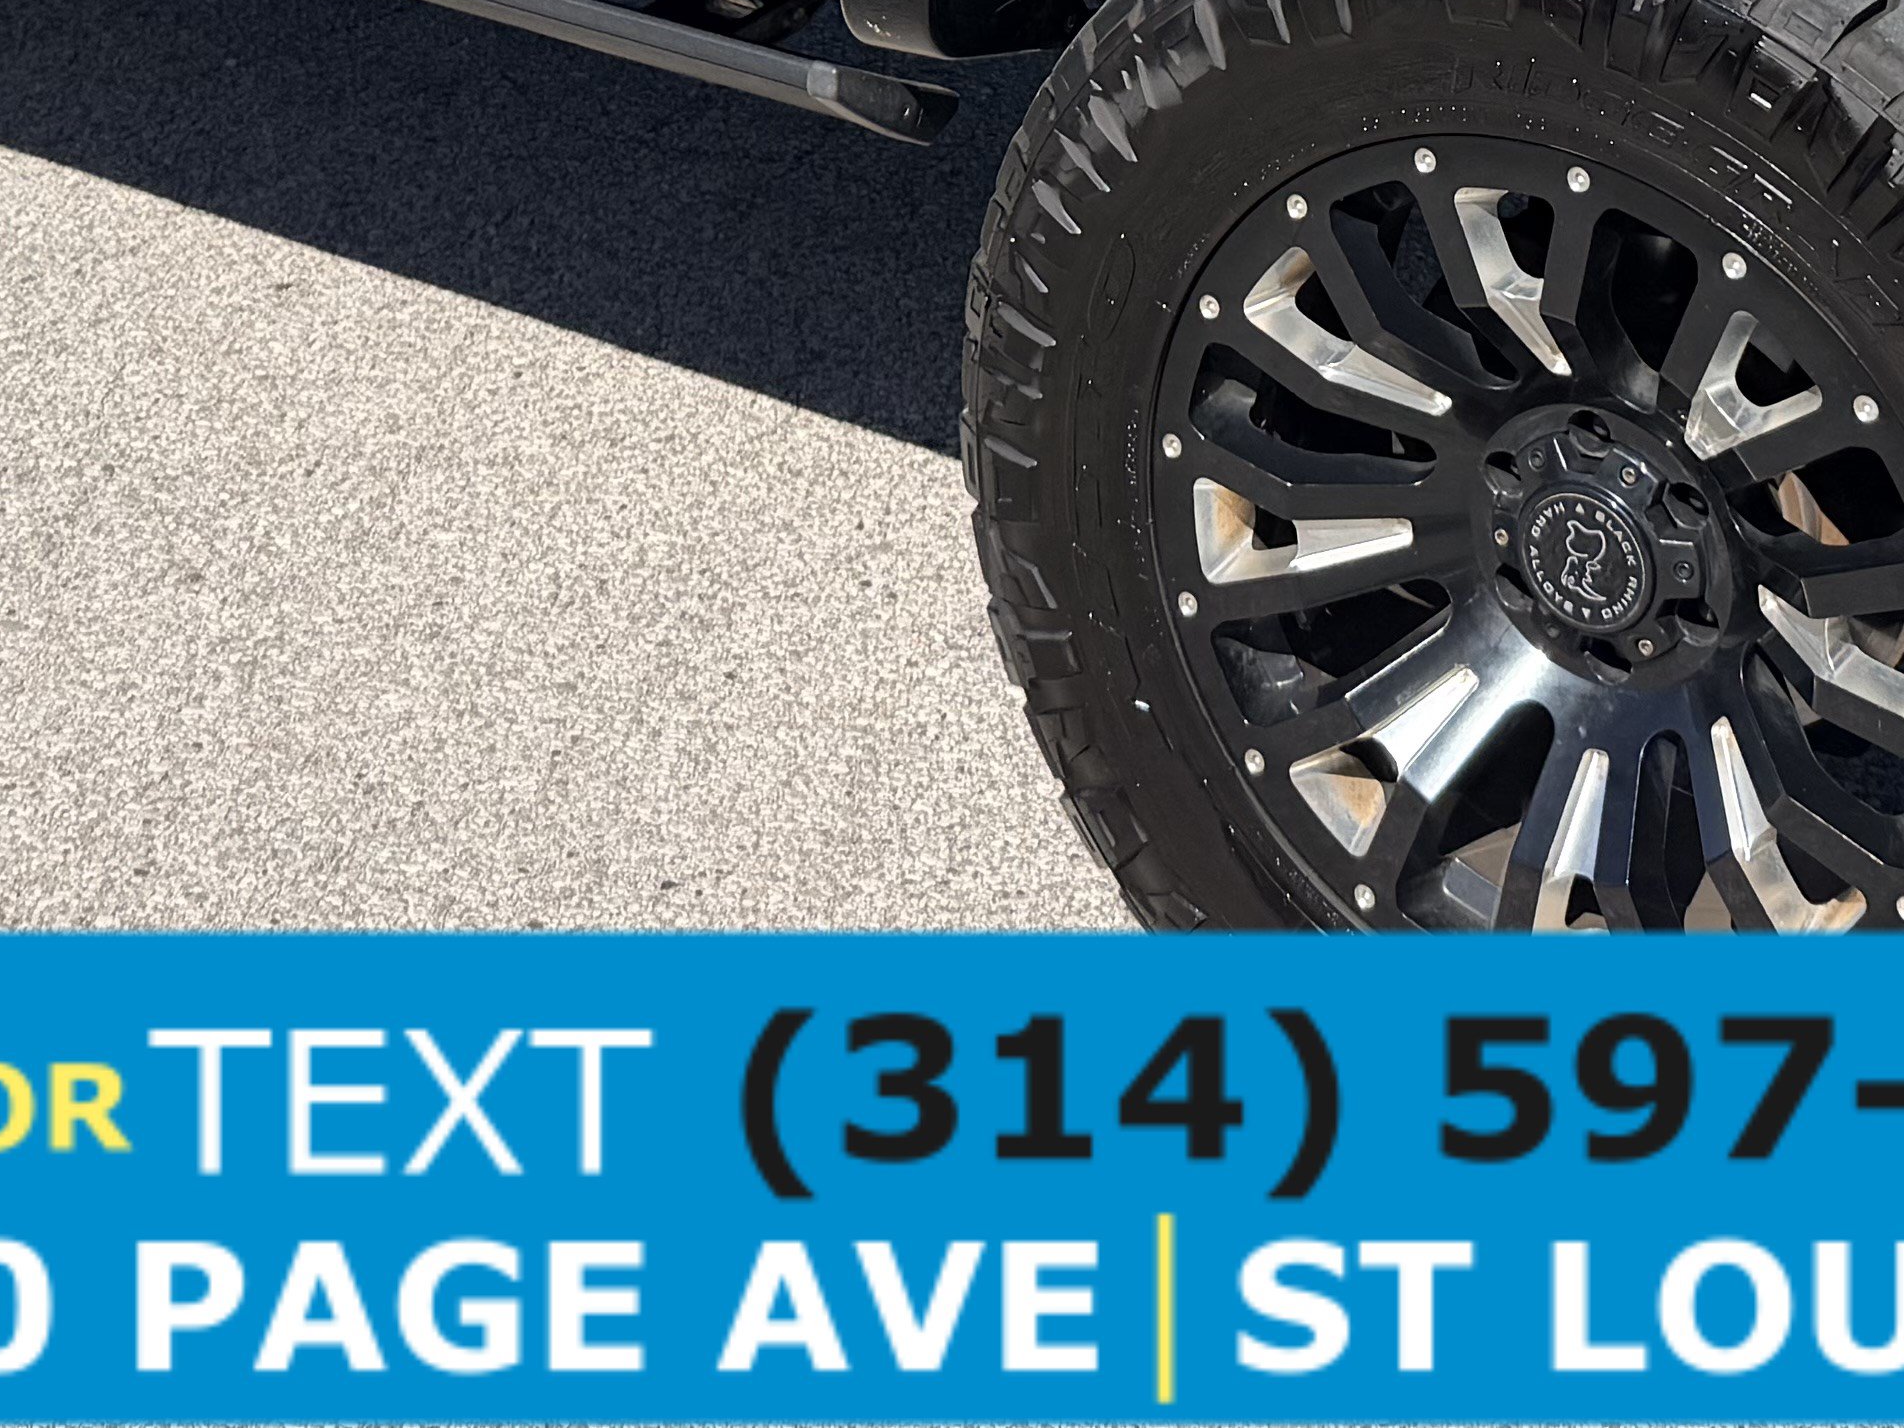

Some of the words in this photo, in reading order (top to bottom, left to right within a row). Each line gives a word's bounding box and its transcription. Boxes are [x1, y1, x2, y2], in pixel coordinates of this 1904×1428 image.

[1530, 501, 1566, 538] HARD
[1595, 509, 1637, 567] BLACK
[1529, 545, 1574, 615] ALLOYS
[1600, 575, 1638, 619] RHINO
